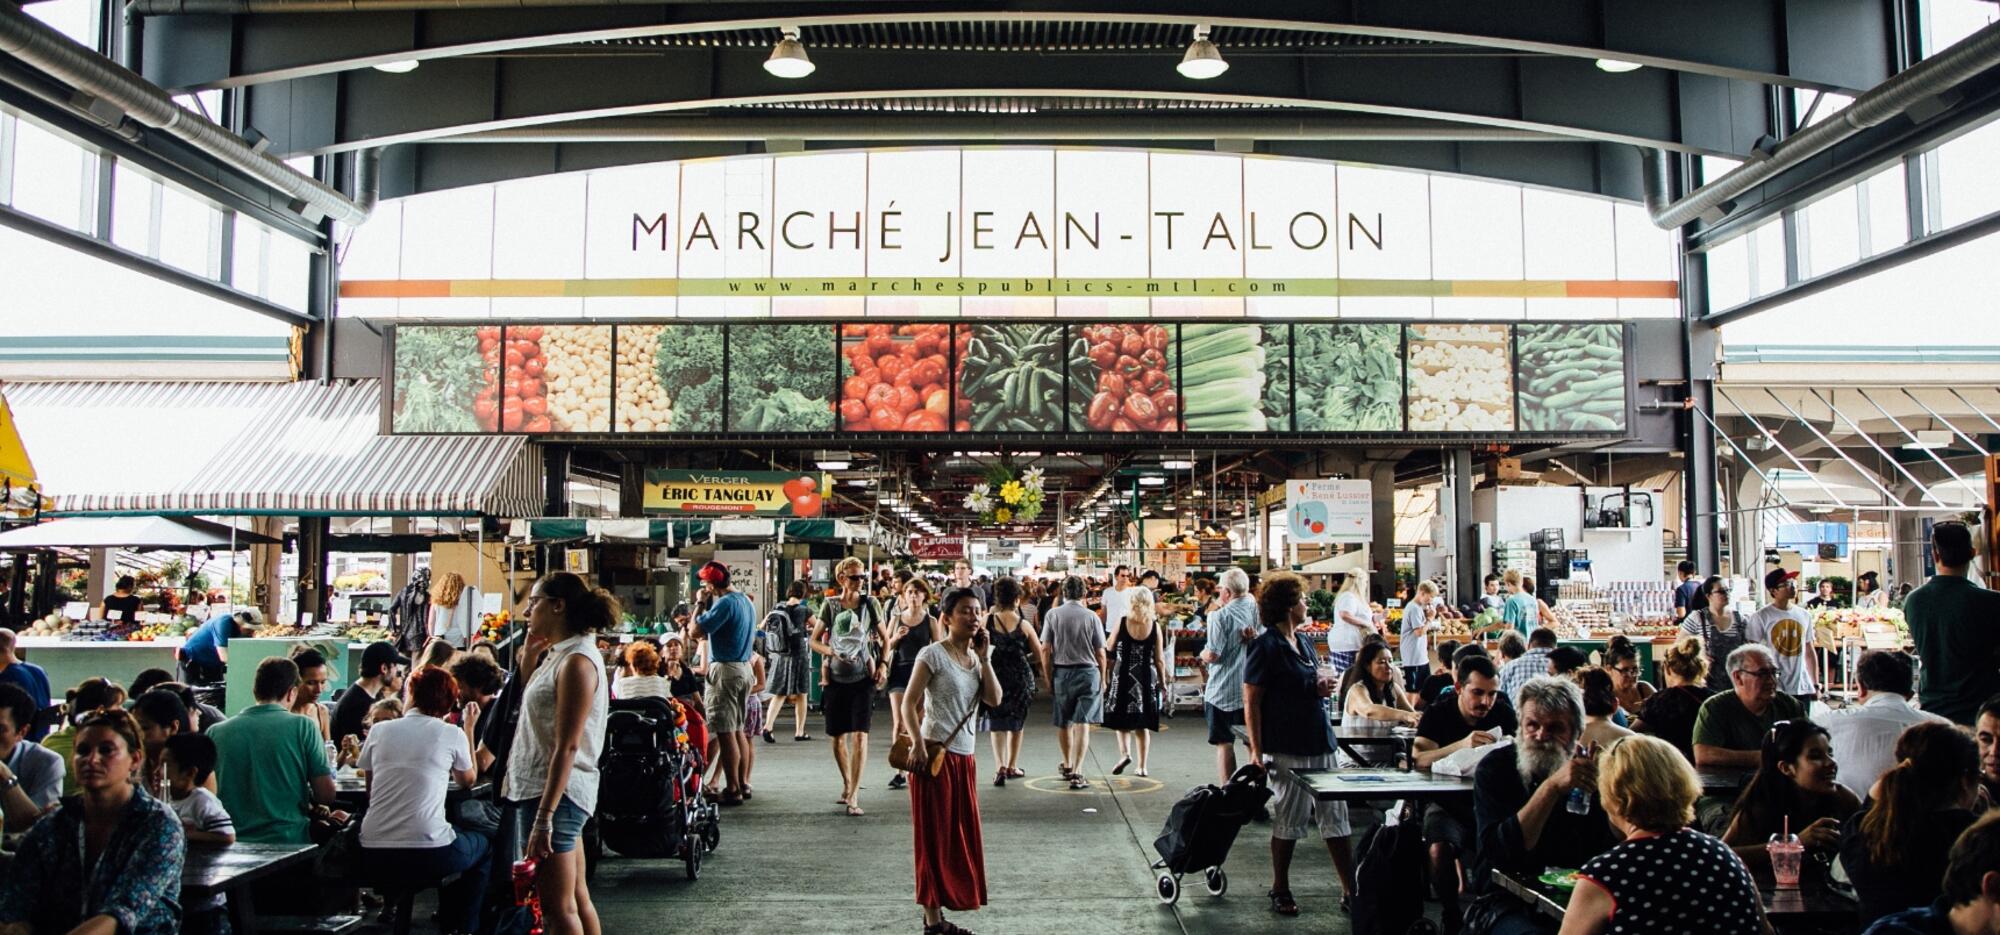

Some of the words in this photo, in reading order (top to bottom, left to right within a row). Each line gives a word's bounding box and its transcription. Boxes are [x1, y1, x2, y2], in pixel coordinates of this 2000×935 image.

[632, 200, 903, 251] MARCHÉ
[938, 210, 1385, 263] JEAN-TALON
[728, 278, 1287, 295] www.marchespublics-mtl.com
[662, 485, 699, 501] ÉRIC
[703, 488, 775, 502] TANGUAY
[692, 504, 744, 512] ROUGEMONT
[918, 537, 965, 546] FLEURISTE
